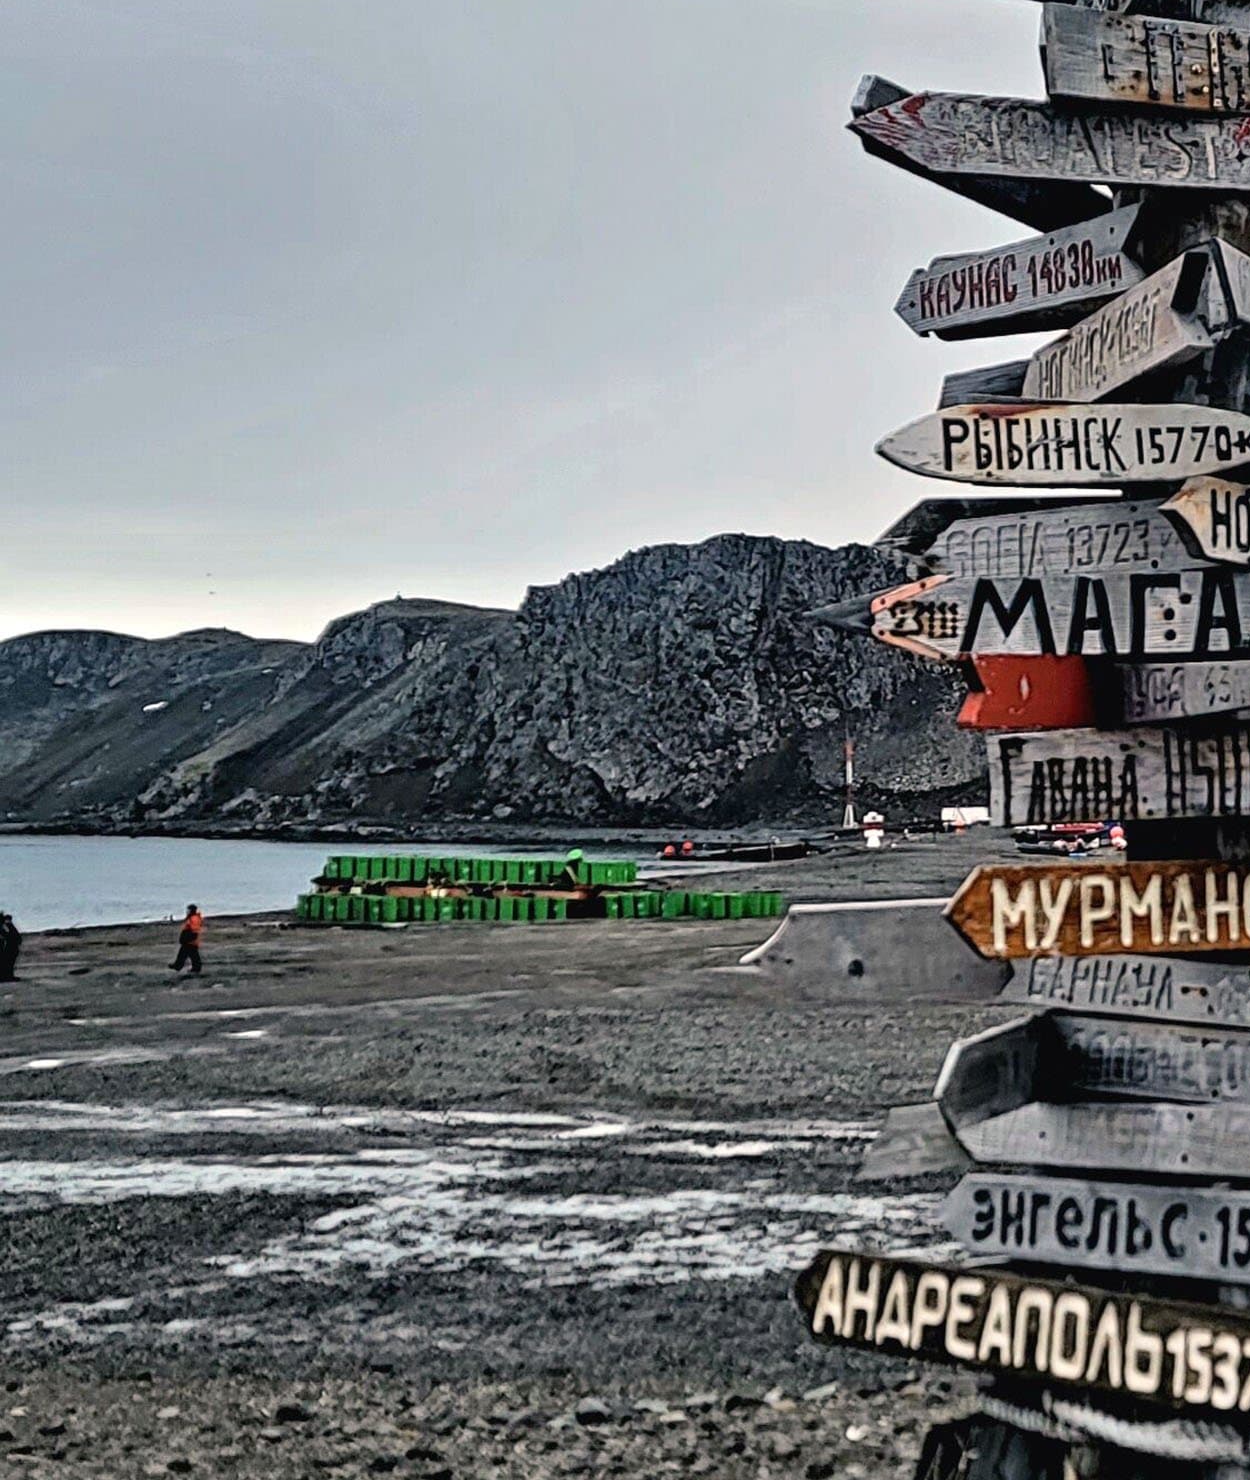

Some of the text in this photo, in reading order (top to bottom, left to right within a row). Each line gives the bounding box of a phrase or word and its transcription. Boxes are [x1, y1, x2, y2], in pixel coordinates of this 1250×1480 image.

[919, 254, 1018, 319] КАУНАС
[941, 417, 1126, 471] РЫБИНСК
[1066, 520, 1150, 568] 13723
[1028, 956, 1173, 1011] БАРНАУЛ
[811, 1255, 1164, 1395] АНДРЕАПОЛЬ
